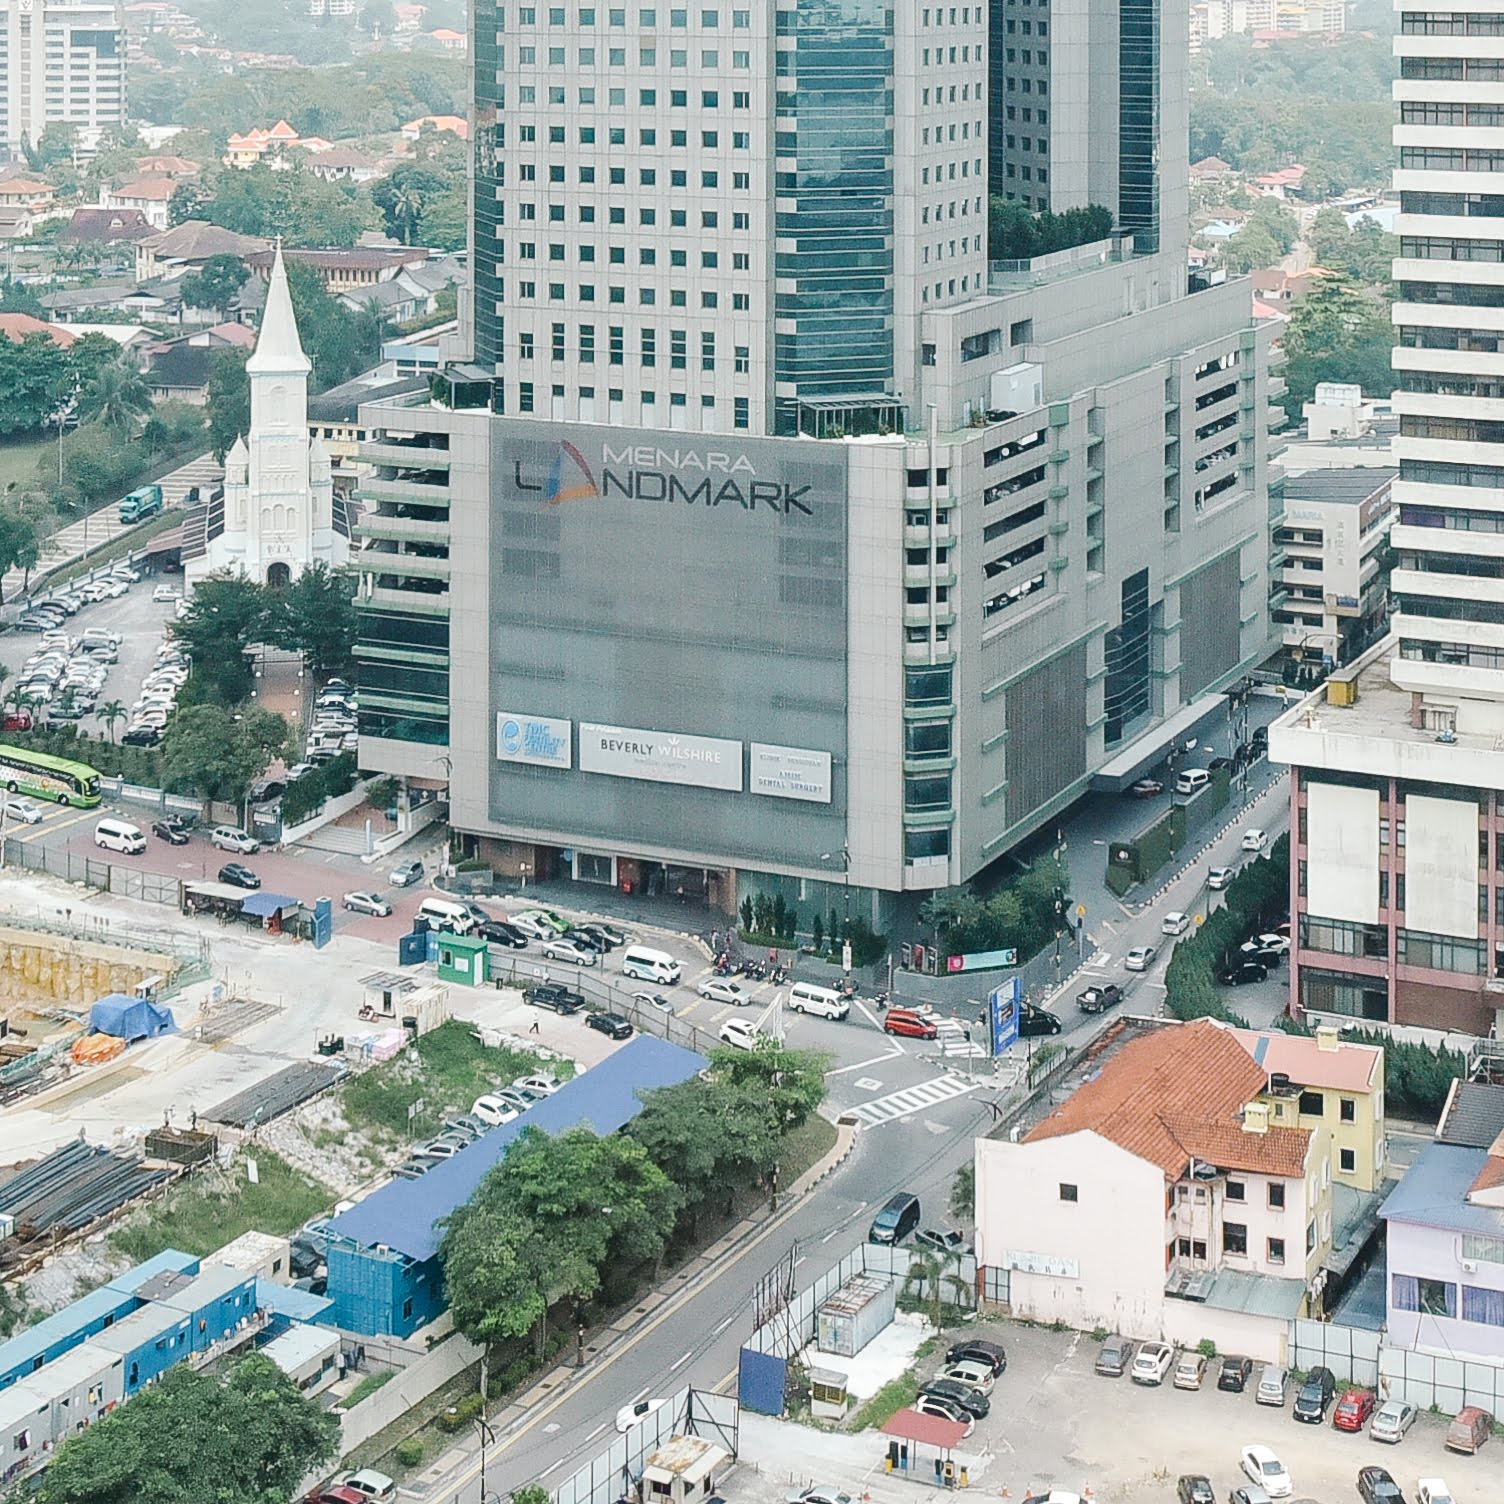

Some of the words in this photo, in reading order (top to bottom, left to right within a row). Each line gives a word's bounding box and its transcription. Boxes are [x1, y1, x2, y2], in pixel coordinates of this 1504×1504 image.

[602, 443, 756, 476] MENARA
[515, 440, 814, 515] LANDMARK
[600, 738, 654, 756] BEVERLY
[657, 744, 721, 764] WILSHIRE
